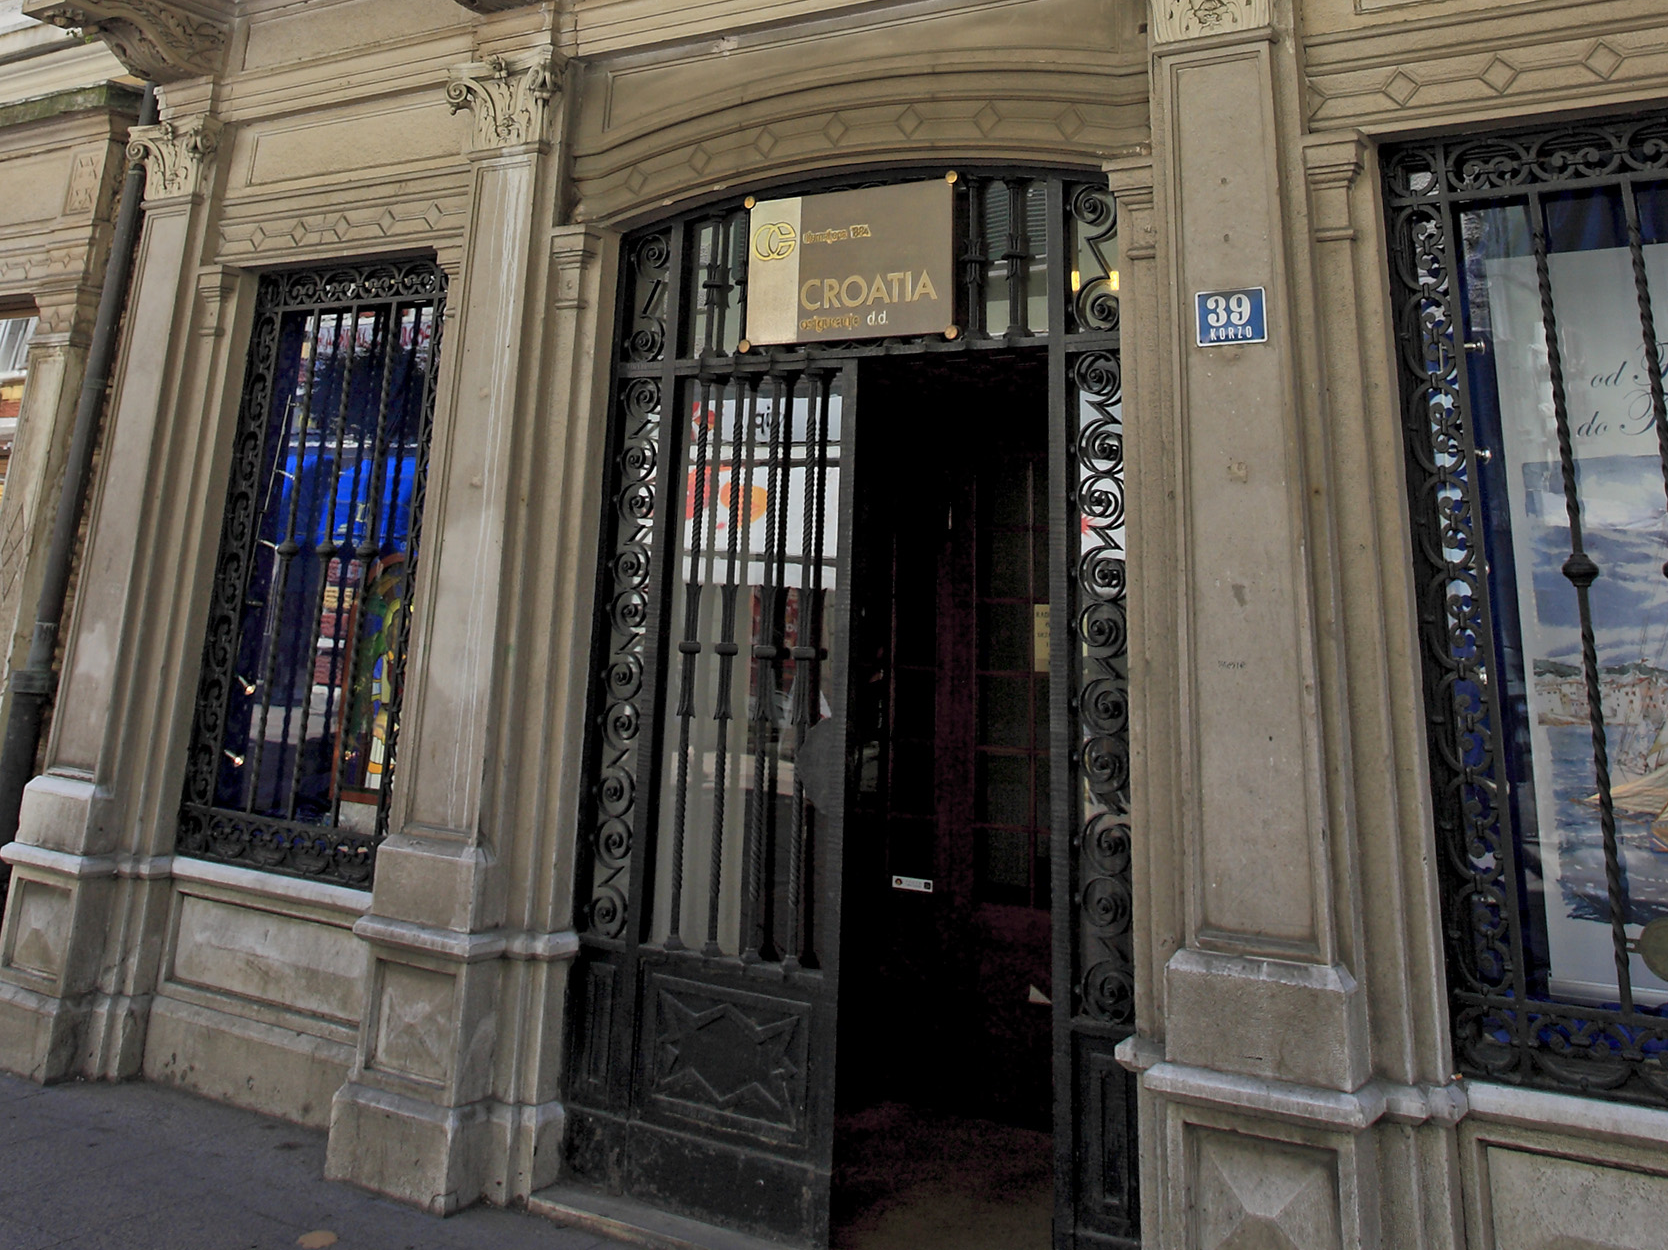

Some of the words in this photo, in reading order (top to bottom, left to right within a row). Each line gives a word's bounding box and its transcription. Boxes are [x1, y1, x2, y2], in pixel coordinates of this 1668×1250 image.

[800, 269, 938, 311] CROATIA
[866, 310, 889, 326] d.d.
[1206, 293, 1251, 327] 39
[1209, 325, 1253, 341] KORZO
[1590, 360, 1628, 388] od
[1577, 410, 1608, 438] do
